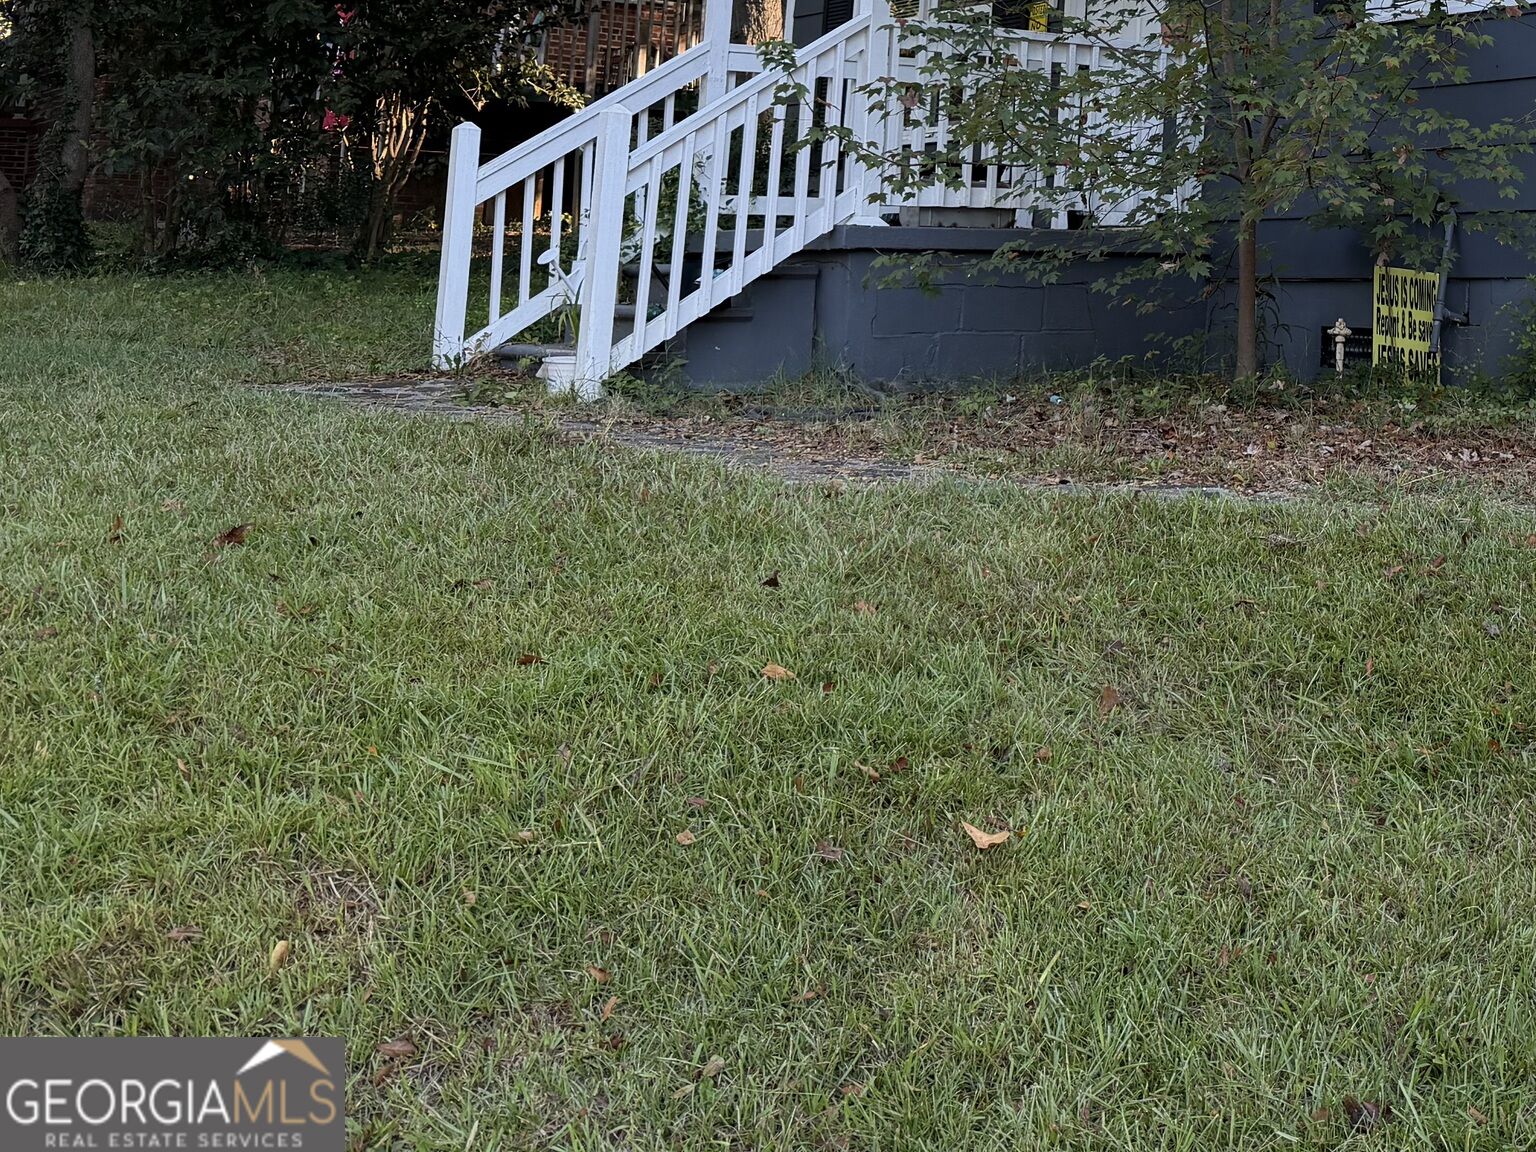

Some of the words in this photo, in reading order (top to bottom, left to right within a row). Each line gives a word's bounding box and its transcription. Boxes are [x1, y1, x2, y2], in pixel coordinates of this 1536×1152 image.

[1376, 273, 1399, 308] JESUS
[1400, 276, 1408, 309] IS
[1409, 277, 1437, 313] COMING
[1401, 309, 1406, 339] &
[1408, 310, 1417, 341] Be
[1418, 320, 1434, 344] save
